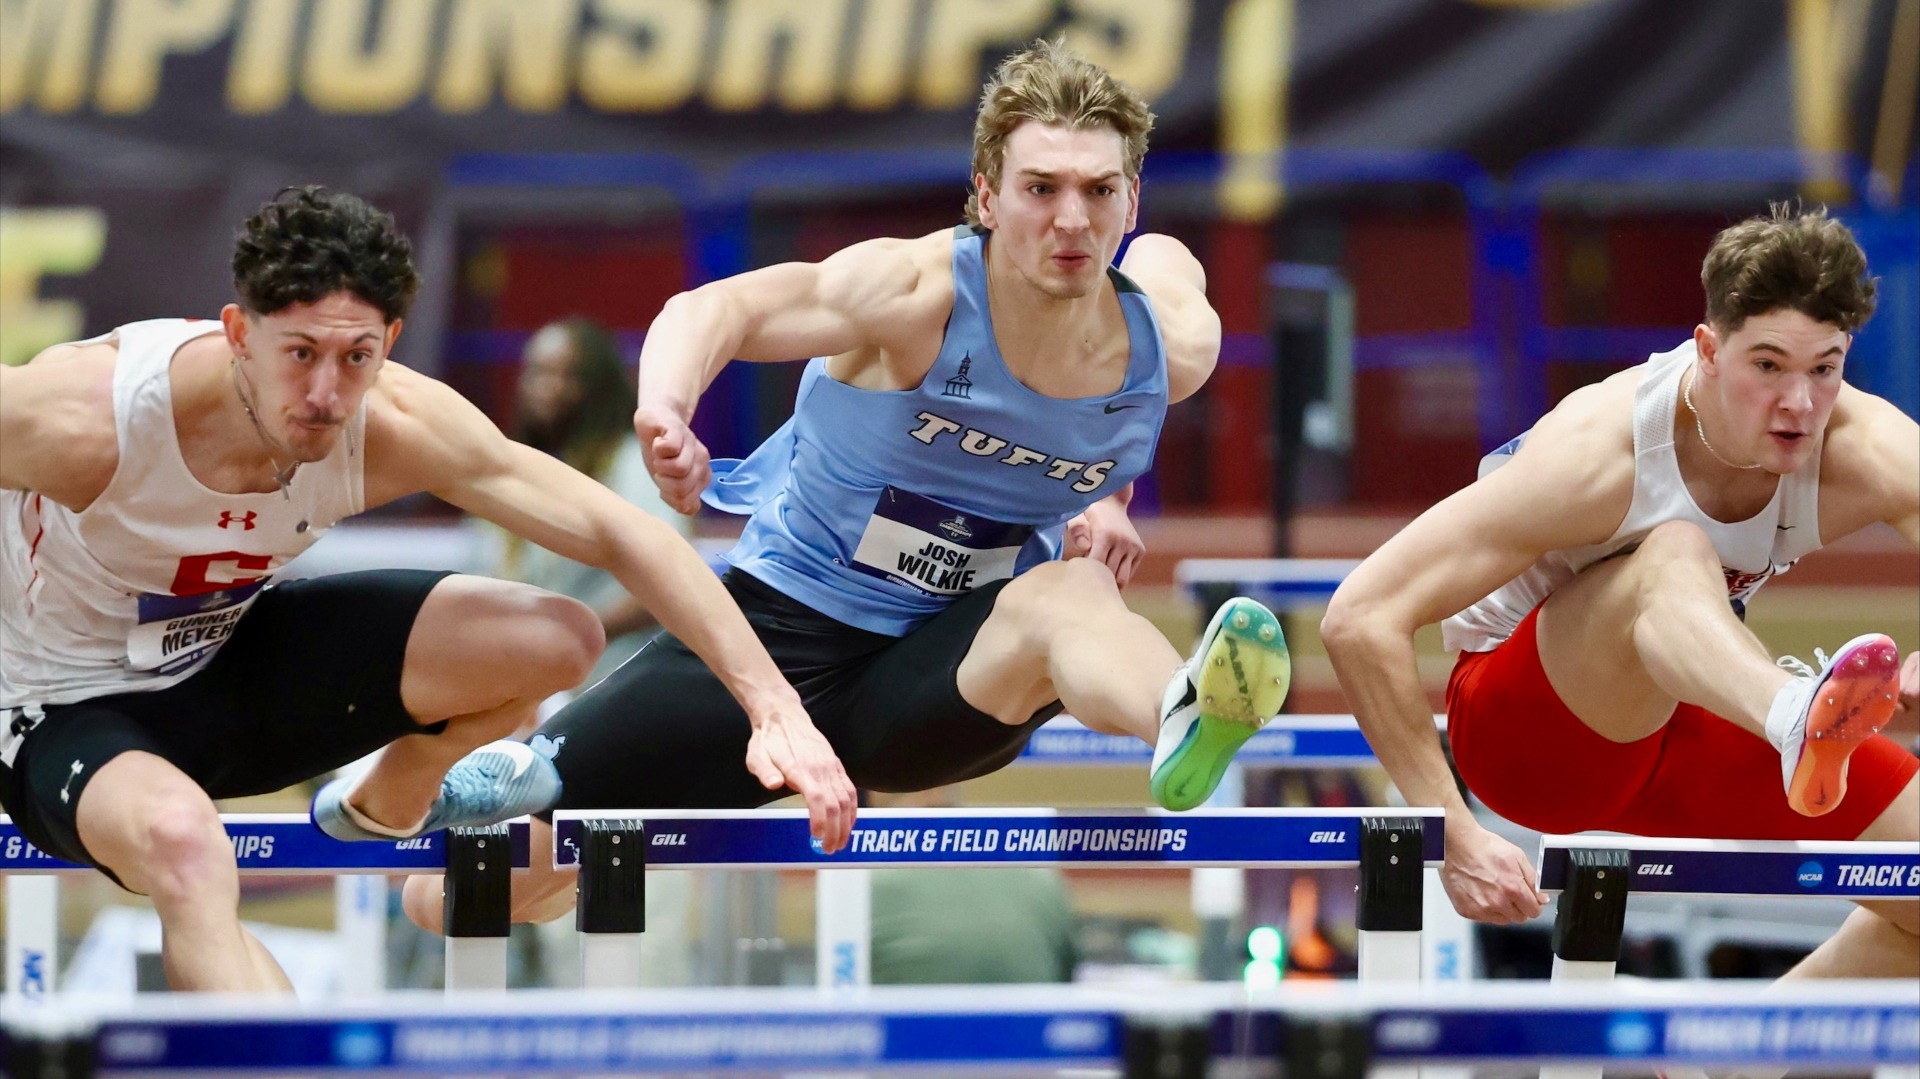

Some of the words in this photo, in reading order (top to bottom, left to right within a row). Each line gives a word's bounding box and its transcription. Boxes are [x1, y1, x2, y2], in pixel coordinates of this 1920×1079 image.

[908, 411, 1118, 494] TUFTS
[918, 541, 971, 569] JOSH
[897, 551, 976, 591] WILKIE
[166, 606, 242, 632] GUNNER
[162, 621, 235, 657] MEYER
[652, 834, 687, 846] GILL
[851, 830, 918, 853] TRACK
[921, 830, 938, 853] &
[941, 829, 1000, 852] FIELD
[1004, 829, 1187, 852] CHAMPIONSHIPS
[1309, 831, 1346, 844] GILL
[1637, 864, 1673, 876] GILL
[1799, 873, 1823, 882] NCAA
[1837, 865, 1908, 887] TRACK
